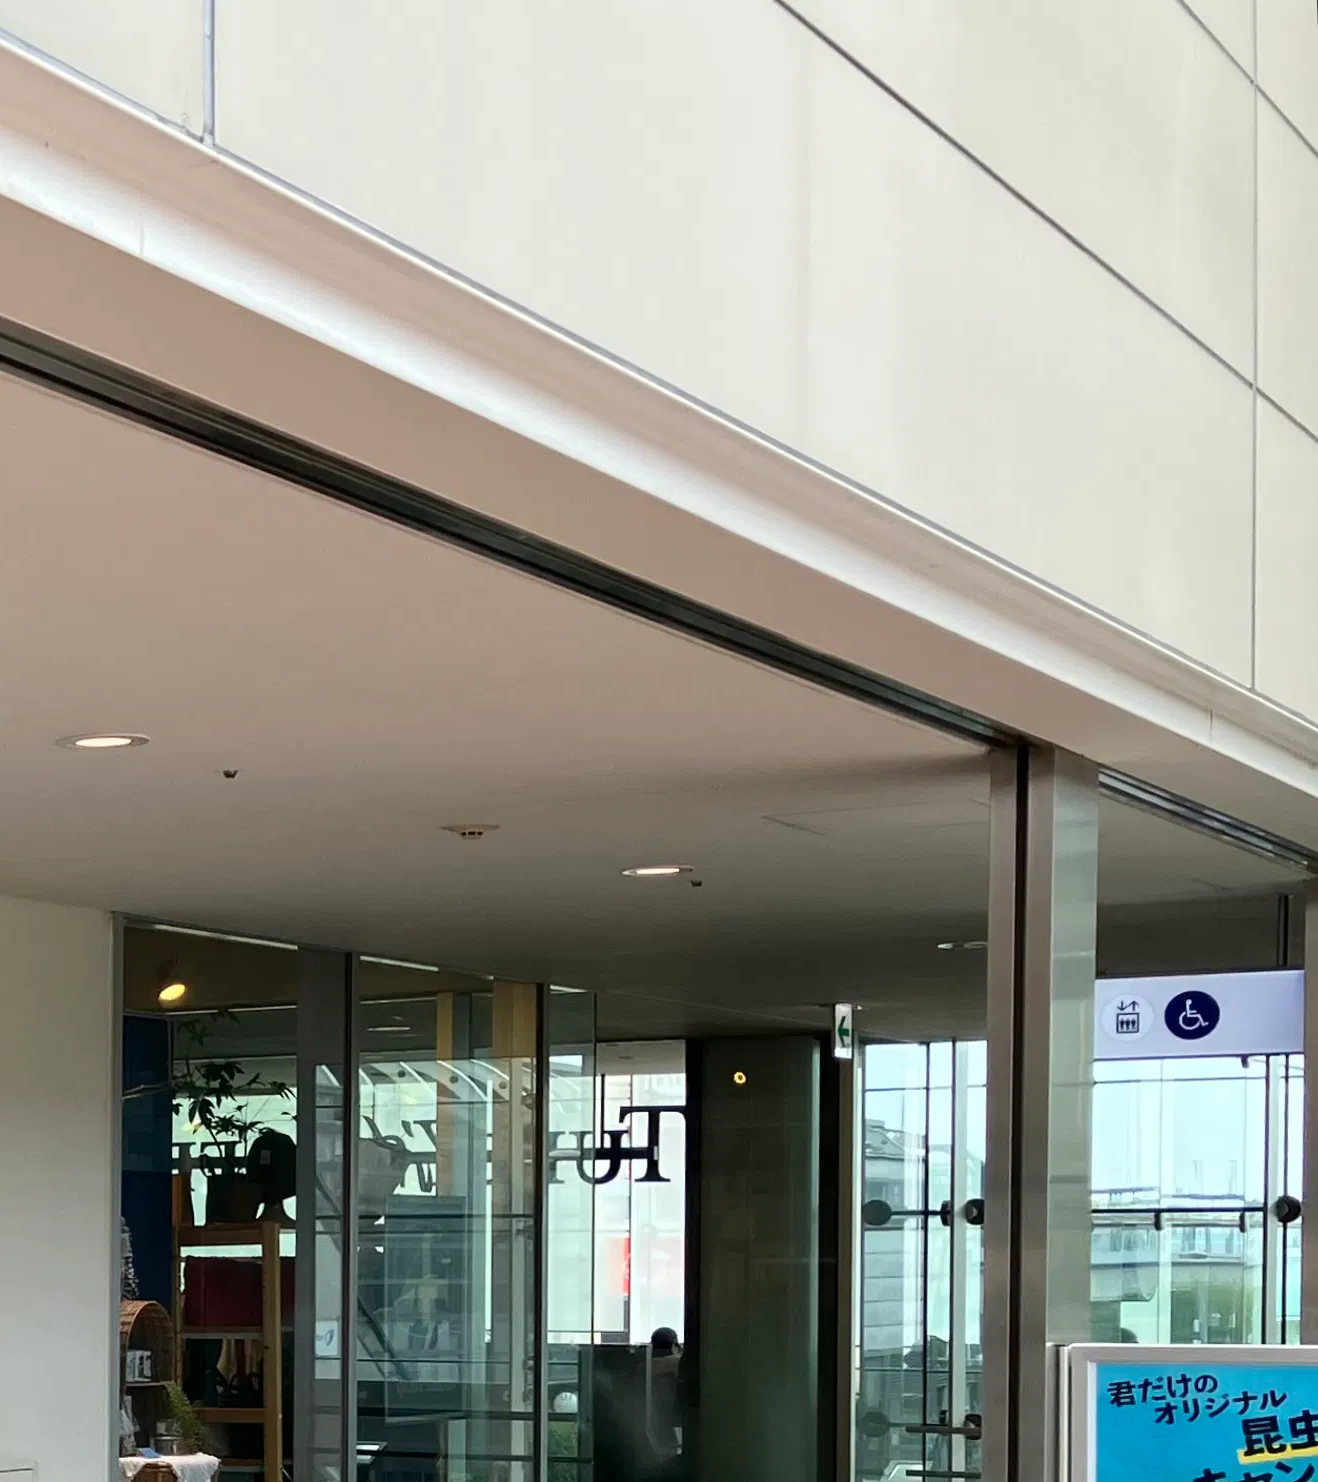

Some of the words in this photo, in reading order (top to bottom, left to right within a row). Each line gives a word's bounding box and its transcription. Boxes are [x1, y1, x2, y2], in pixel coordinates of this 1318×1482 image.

[1107, 1373, 1218, 1408] 君だけの
[1154, 1389, 1288, 1425] オリジナル
